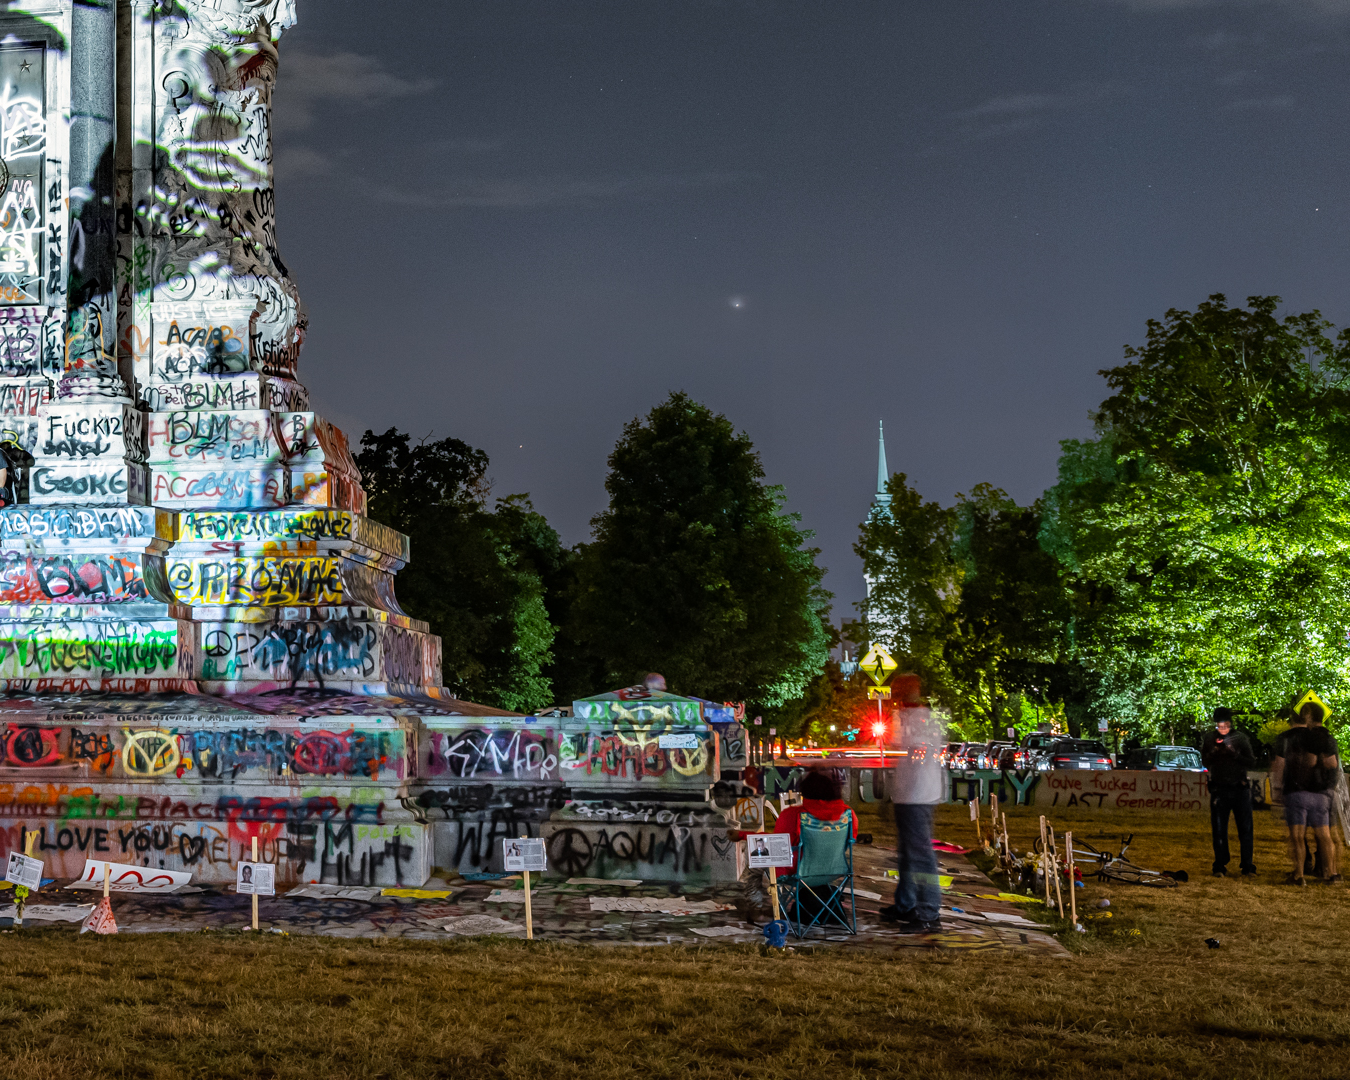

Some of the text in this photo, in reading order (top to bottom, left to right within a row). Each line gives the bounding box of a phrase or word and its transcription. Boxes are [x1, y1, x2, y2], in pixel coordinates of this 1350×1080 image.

[180, 381, 239, 410] BLM
[168, 411, 230, 445] BLM
[231, 436, 270, 460] BLM
[77, 508, 143, 536] BLM
[1090, 772, 1137, 791] fucked
[1116, 792, 1202, 810] Generation
[39, 826, 110, 852] LOVE
[118, 827, 170, 852] YOU
